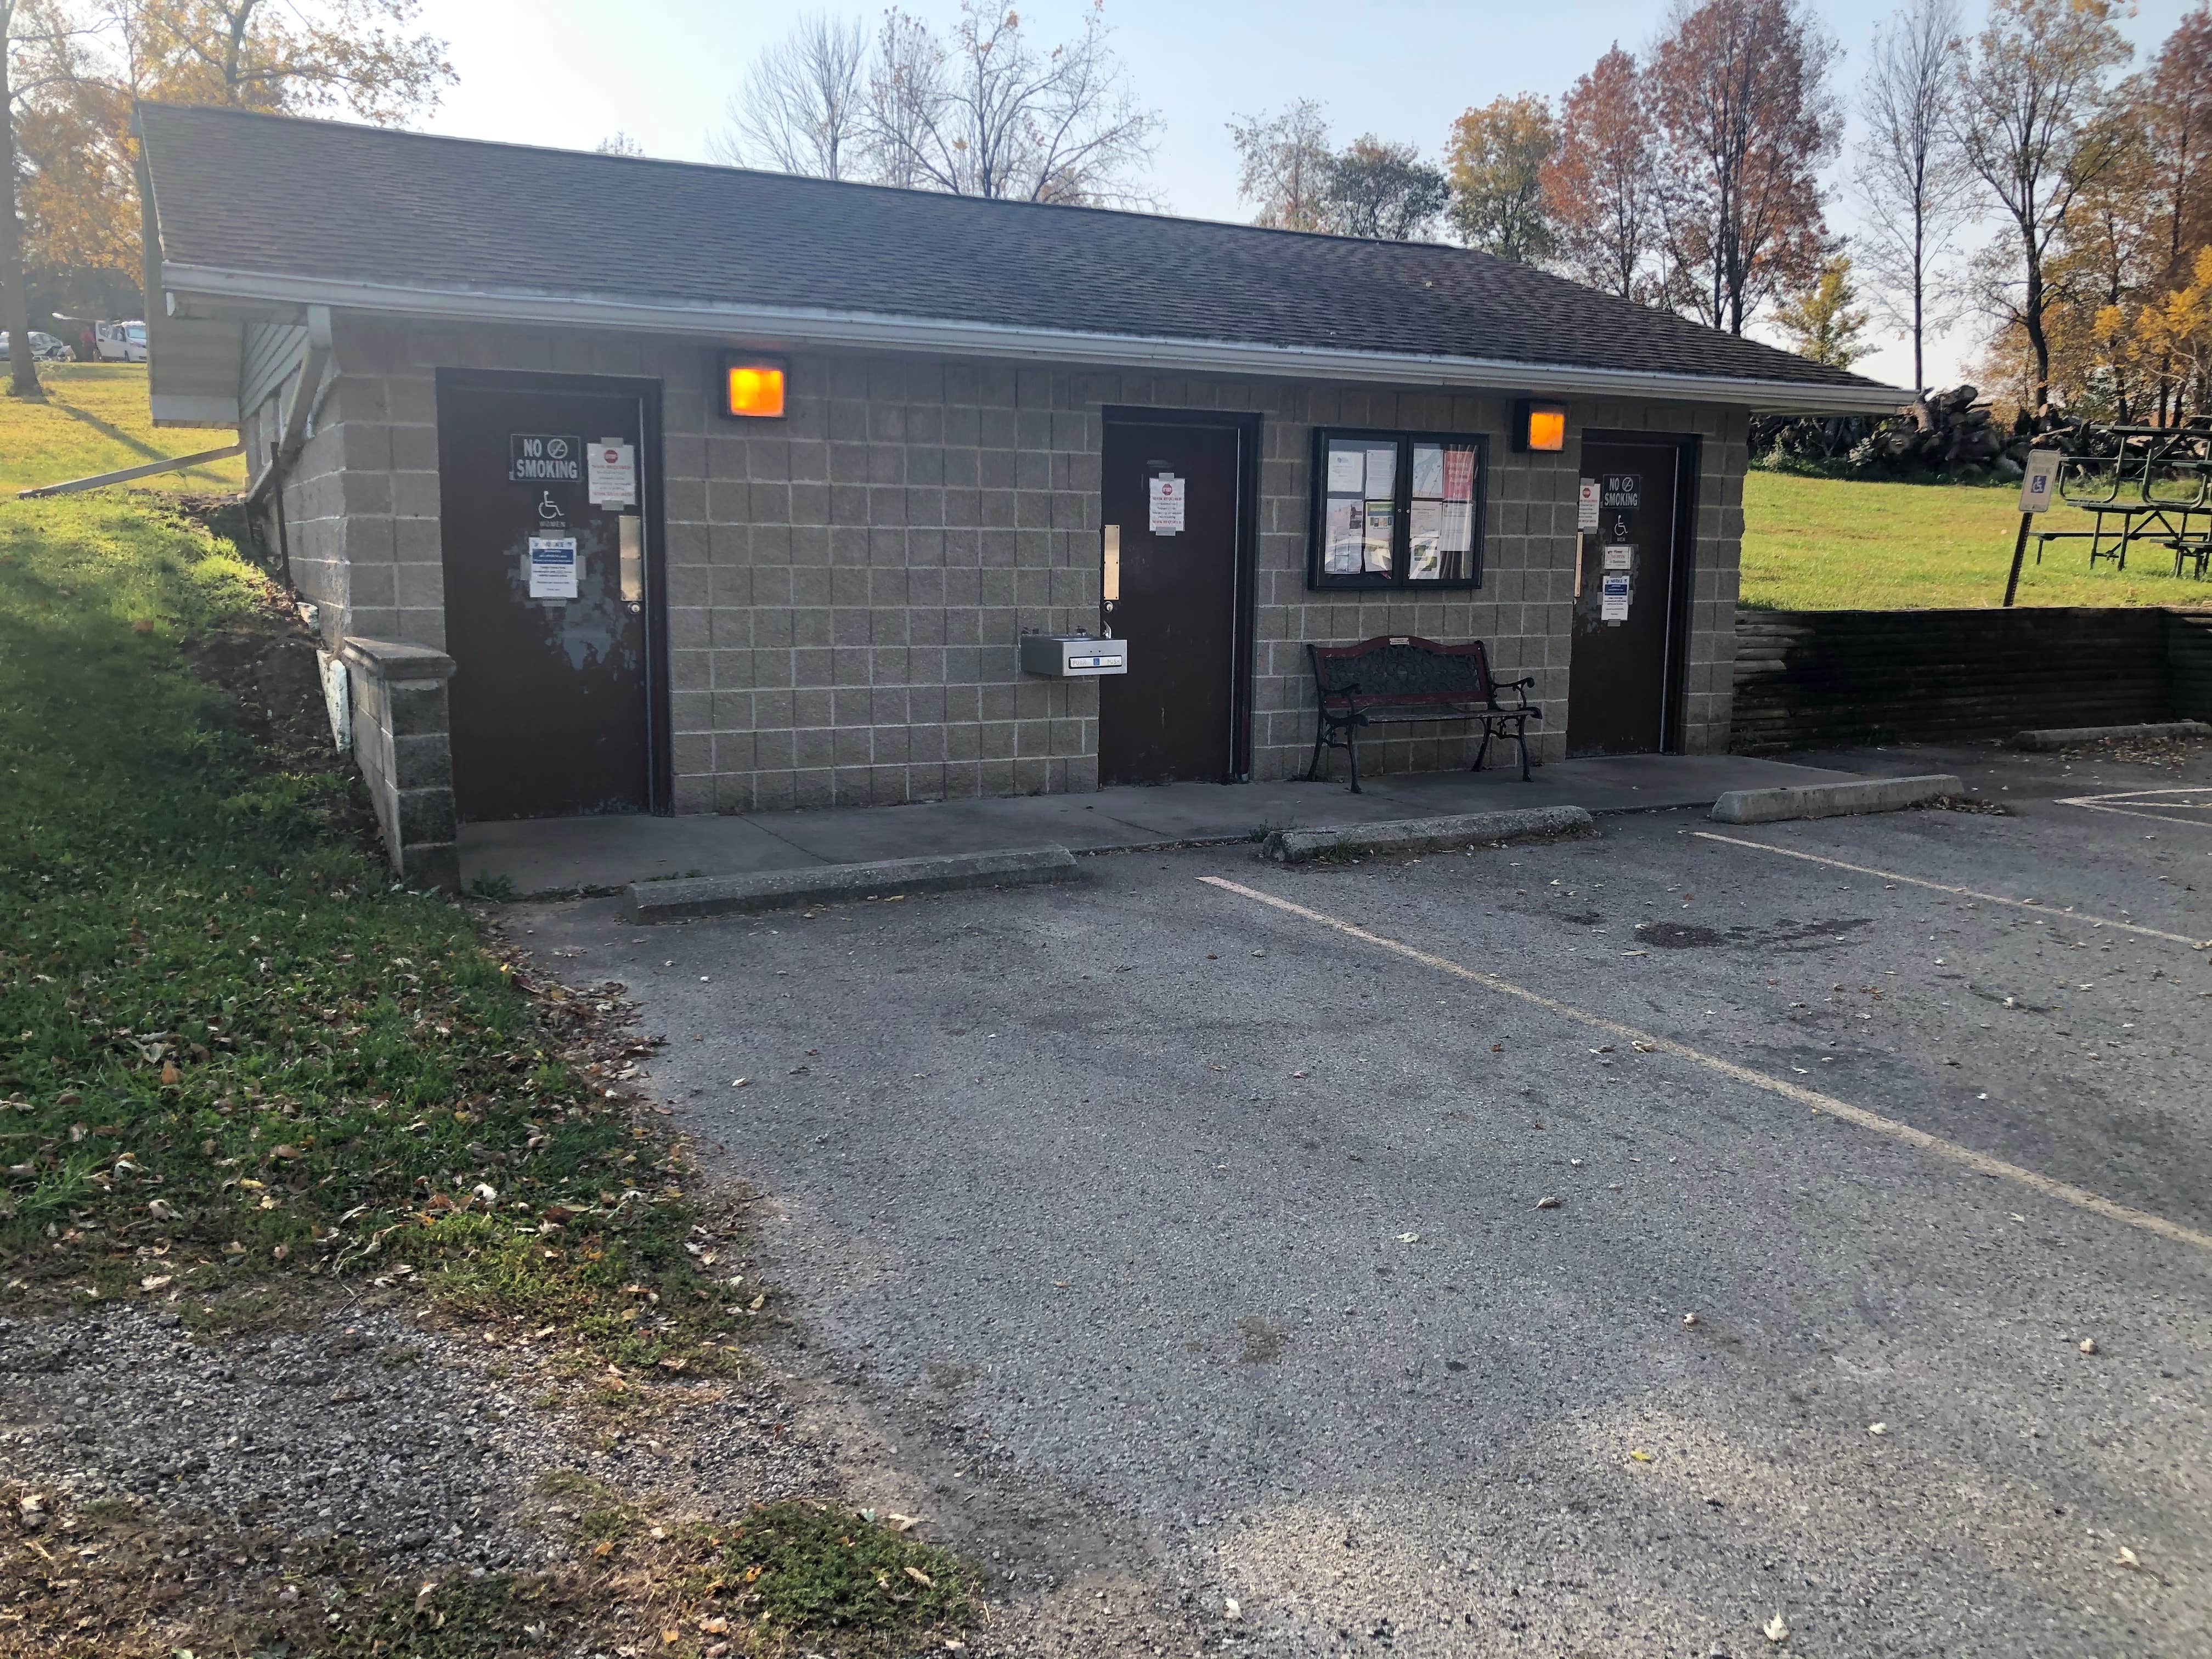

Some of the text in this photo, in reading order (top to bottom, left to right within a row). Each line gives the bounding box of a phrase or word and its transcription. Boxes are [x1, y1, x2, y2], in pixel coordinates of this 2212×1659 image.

[524, 439, 541, 457] NO
[517, 459, 577, 478] SMOKING
[1610, 477, 1620, 491] NO
[1604, 493, 1638, 506] SMOKING
